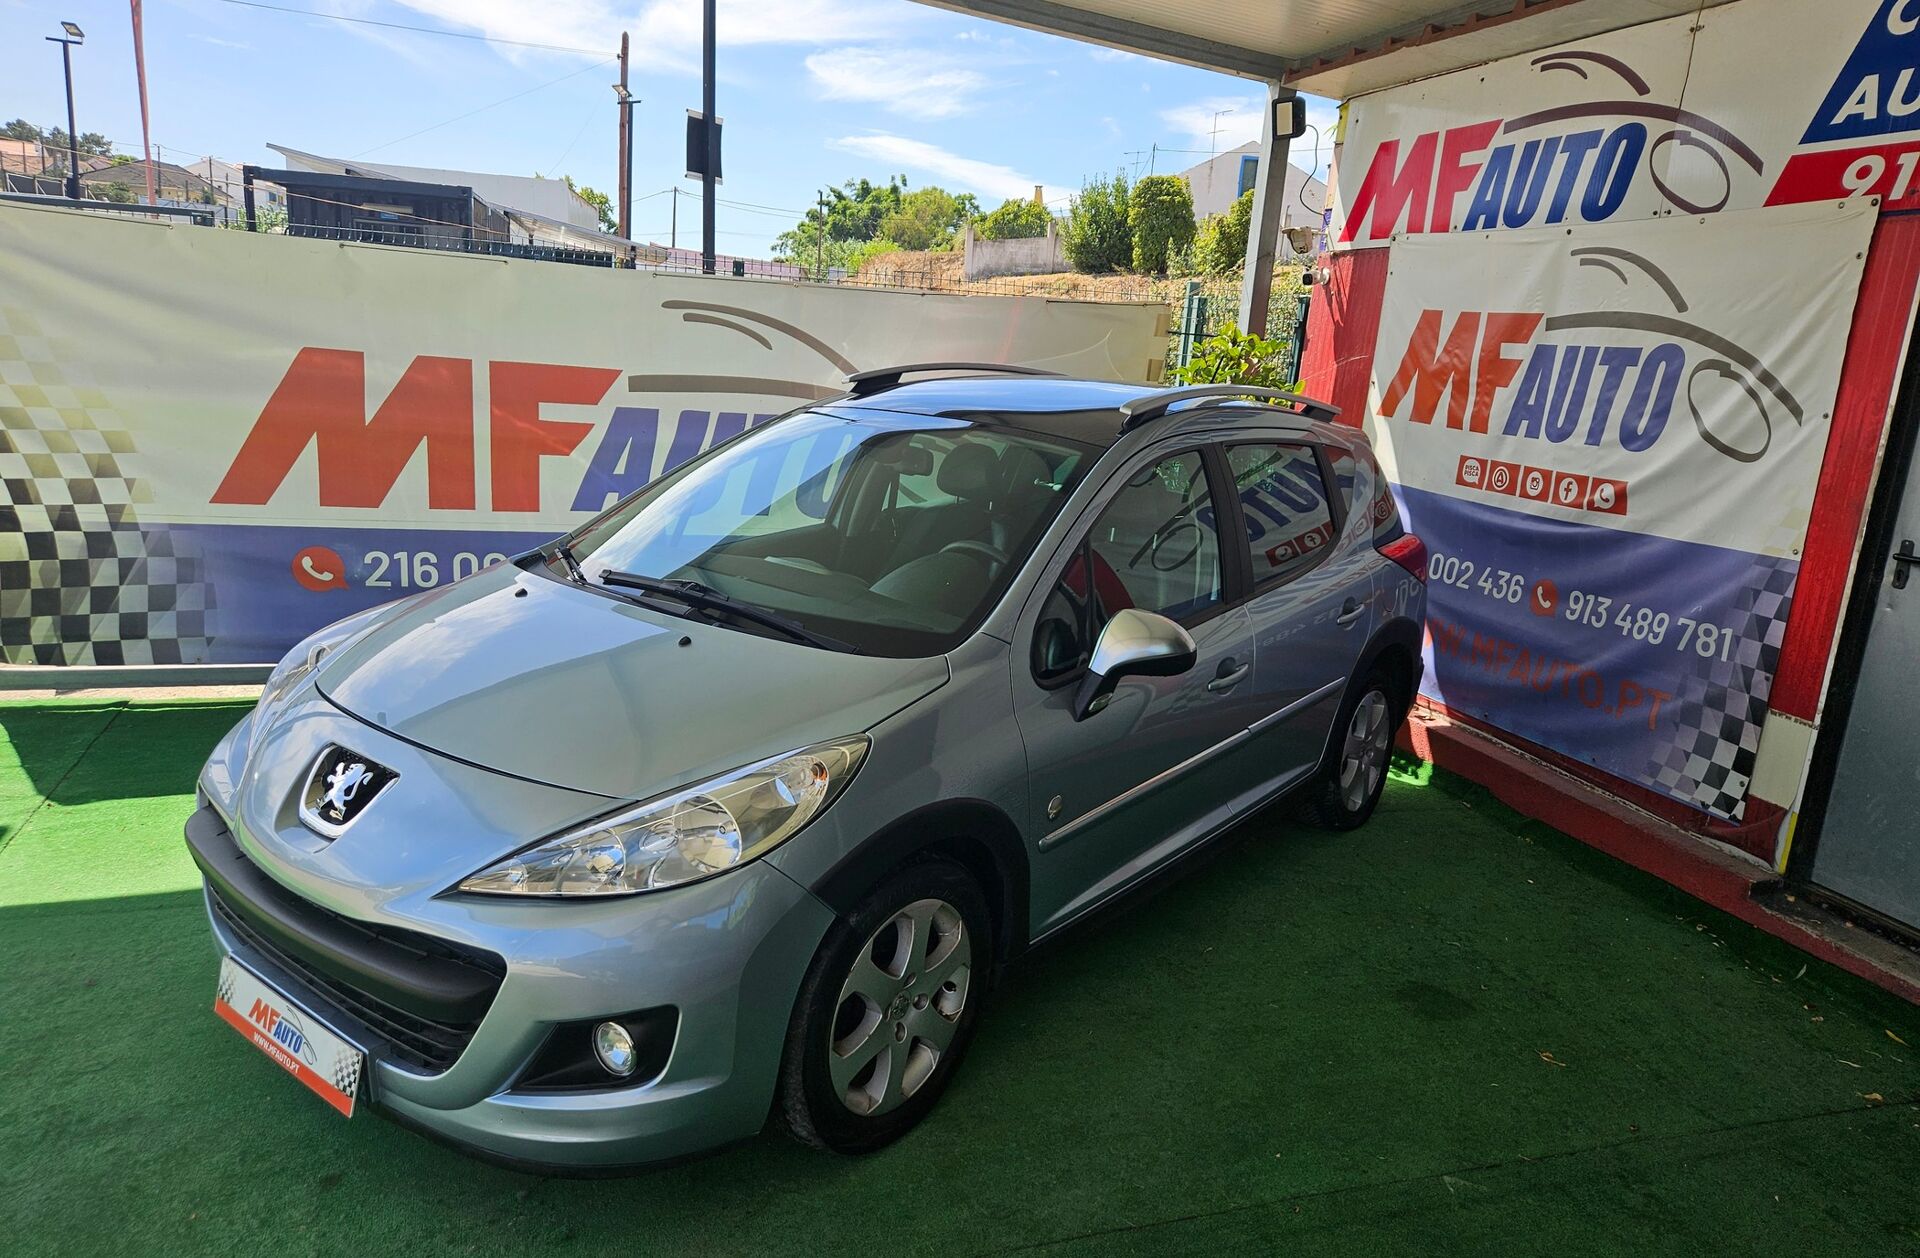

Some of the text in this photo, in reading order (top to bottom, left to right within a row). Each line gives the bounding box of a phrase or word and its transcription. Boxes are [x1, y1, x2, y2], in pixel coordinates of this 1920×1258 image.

[363, 551, 439, 588] 216
[1429, 553, 1733, 662] 002 436 913 489 781
